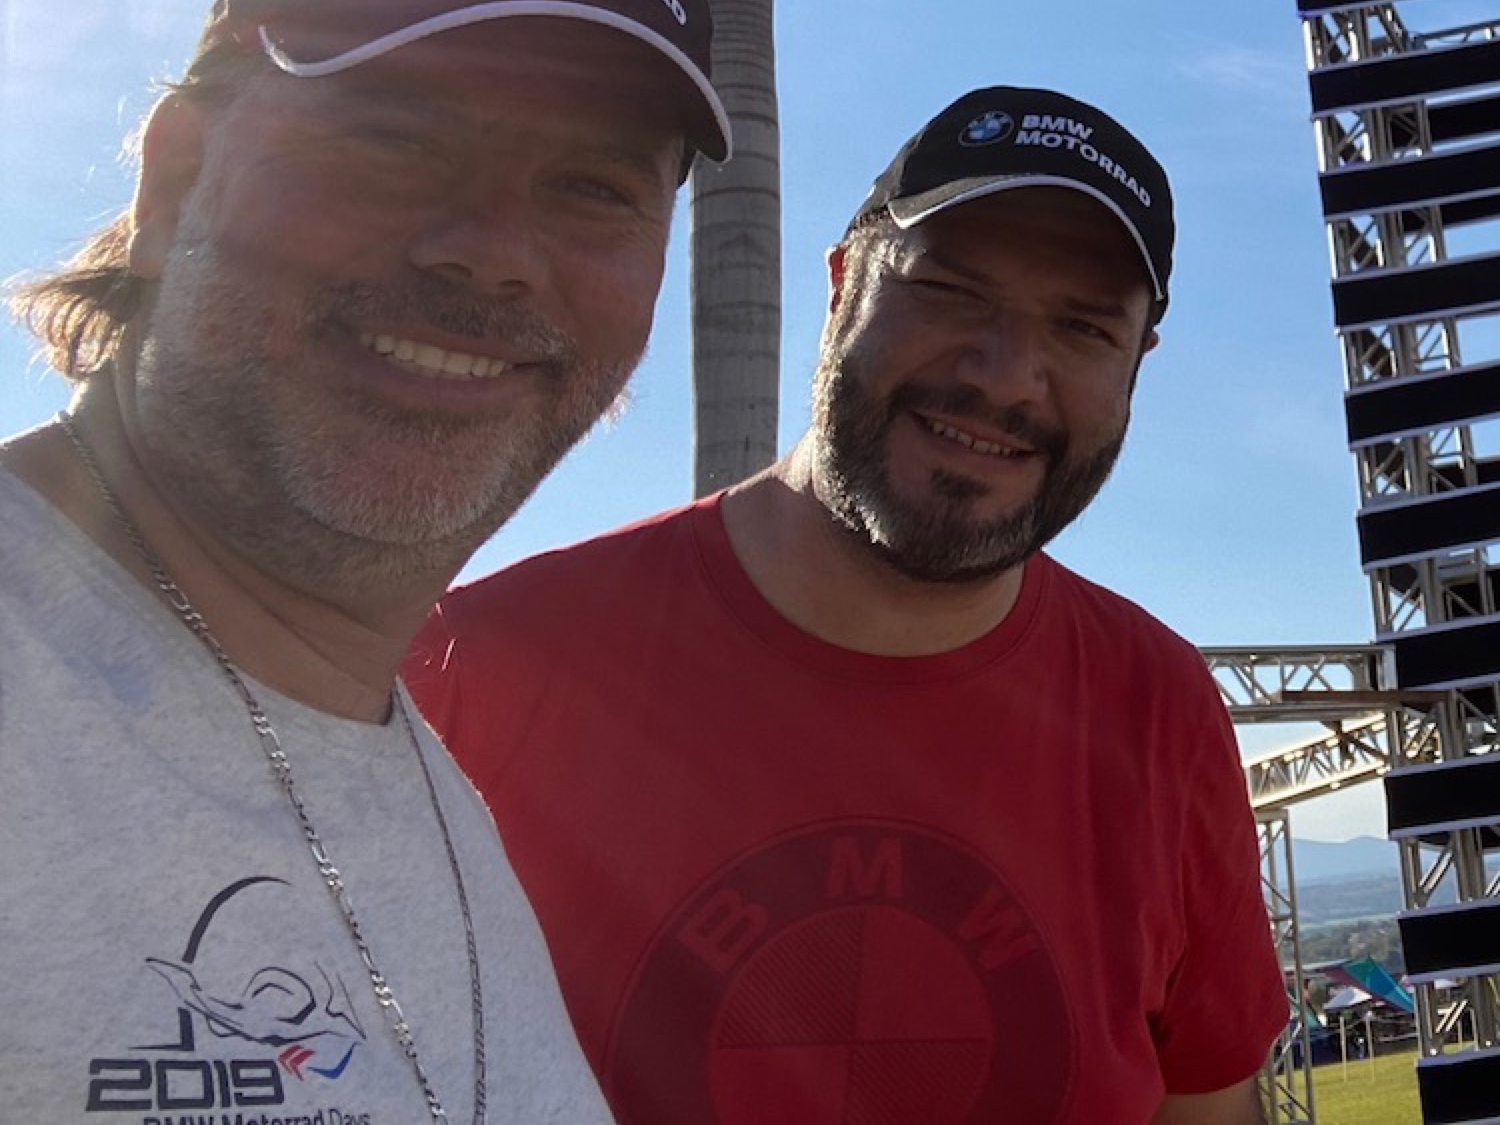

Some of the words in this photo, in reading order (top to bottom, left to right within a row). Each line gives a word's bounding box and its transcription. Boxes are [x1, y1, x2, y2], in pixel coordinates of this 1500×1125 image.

[1022, 114, 1094, 140] BMW
[1015, 129, 1152, 208] MOTORRAD
[678, 835, 1042, 972] BMW
[86, 1059, 284, 1111] 2019
